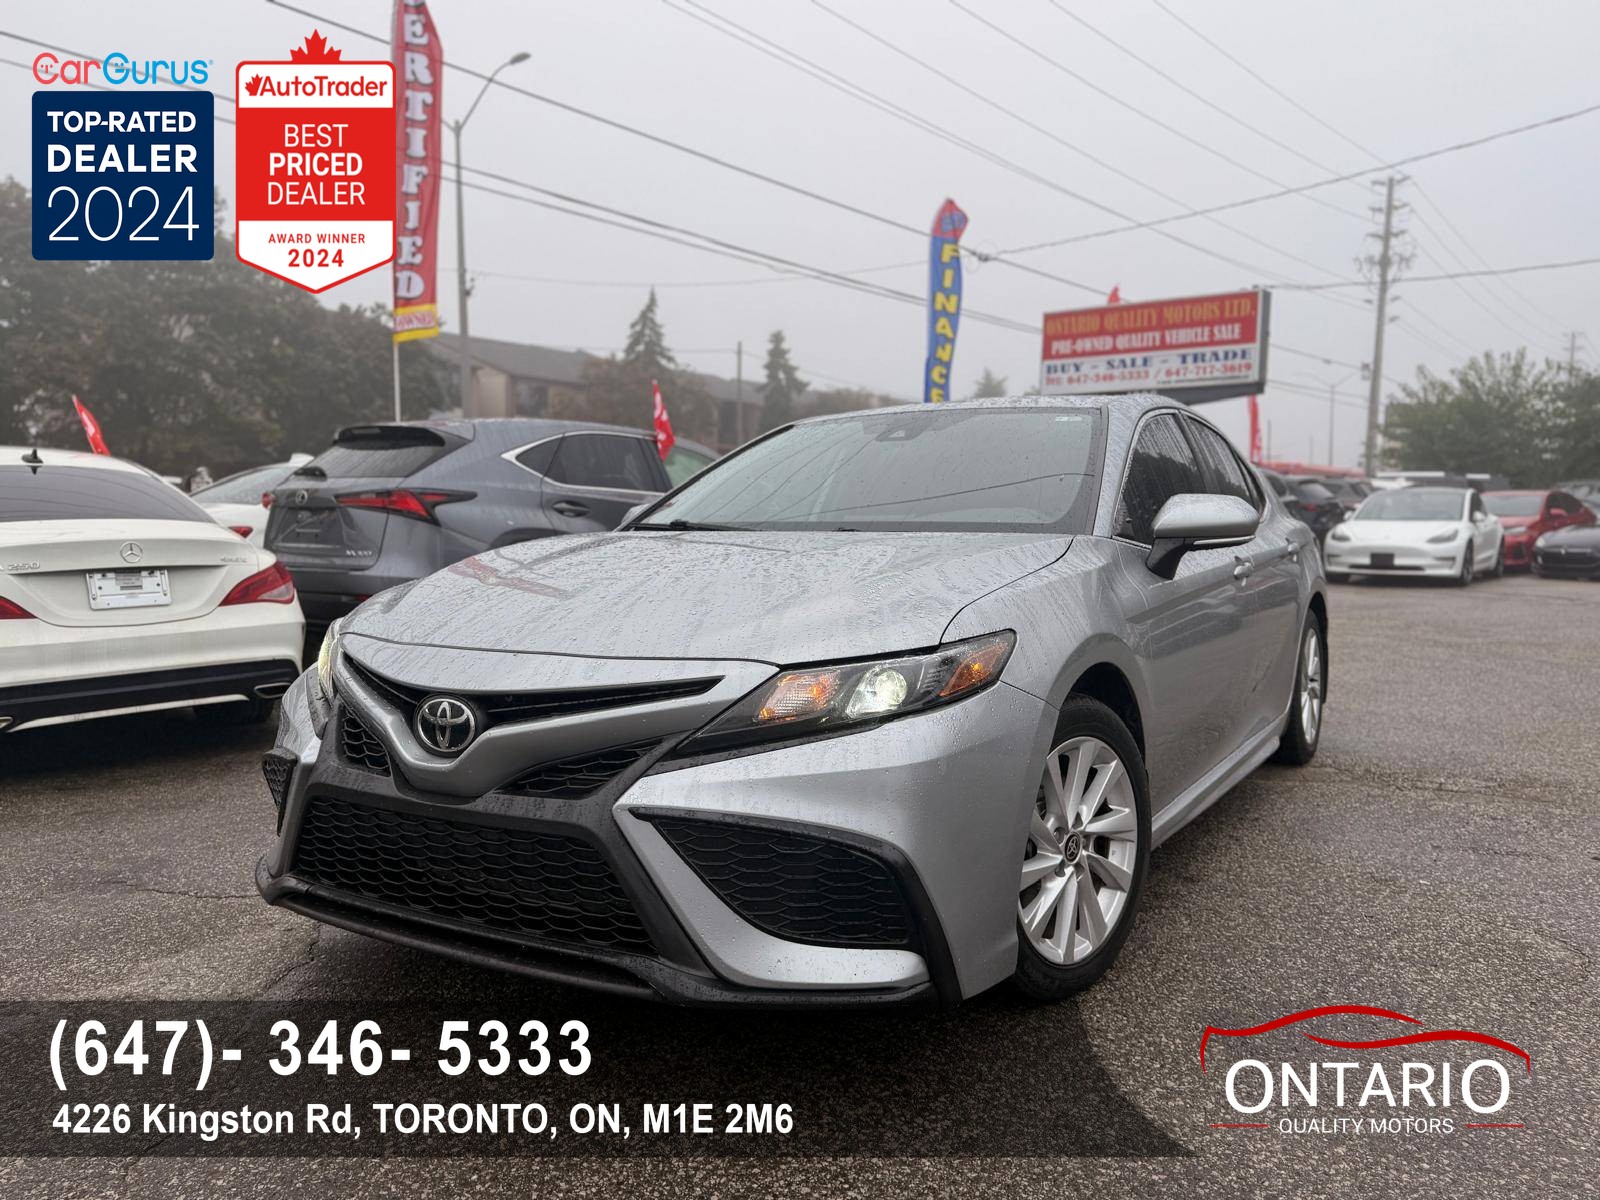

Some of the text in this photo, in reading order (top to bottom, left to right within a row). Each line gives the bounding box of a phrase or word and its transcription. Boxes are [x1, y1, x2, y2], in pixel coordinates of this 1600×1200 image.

[394, 0, 433, 300] ERTIFIED
[930, 243, 960, 404] FINANCE
[1046, 313, 1100, 336] ONTARIO
[1104, 305, 1157, 331] QUALITY
[1163, 301, 1220, 326] MOTORS
[1051, 322, 1242, 356] PRE-OWNED QUALITY VEHICLE SALE
[1046, 362, 1084, 375] BUY
[1106, 356, 1152, 370] SALE
[1178, 349, 1251, 365] TRADE
